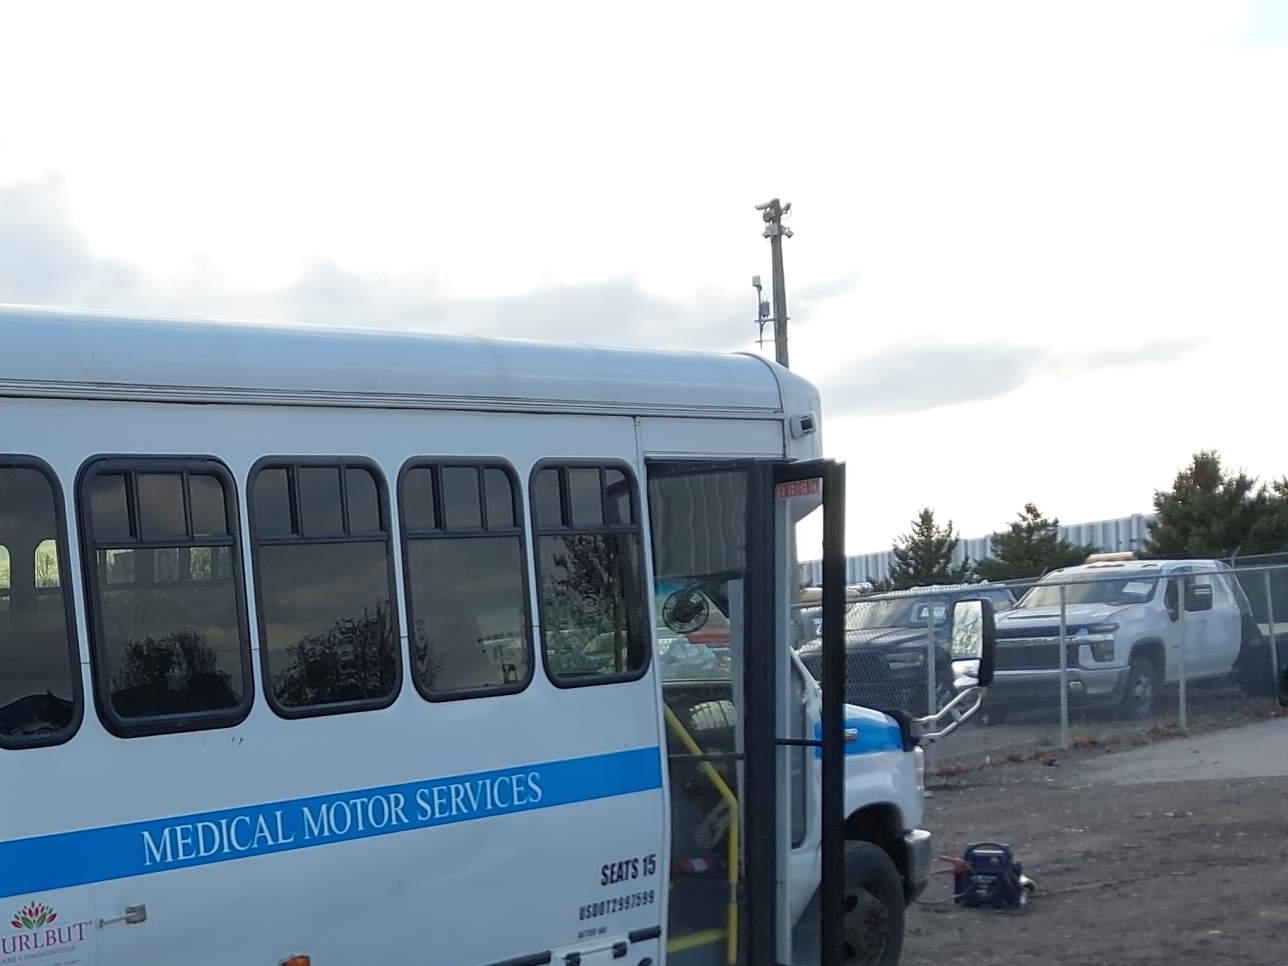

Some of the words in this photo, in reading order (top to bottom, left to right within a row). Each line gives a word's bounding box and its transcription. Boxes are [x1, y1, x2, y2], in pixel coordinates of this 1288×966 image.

[141, 809, 294, 866] MEDICAL
[302, 792, 410, 840] MOTOR
[416, 771, 543, 821] SERVICES
[600, 857, 639, 886] SEATS
[643, 853, 657, 877] 15
